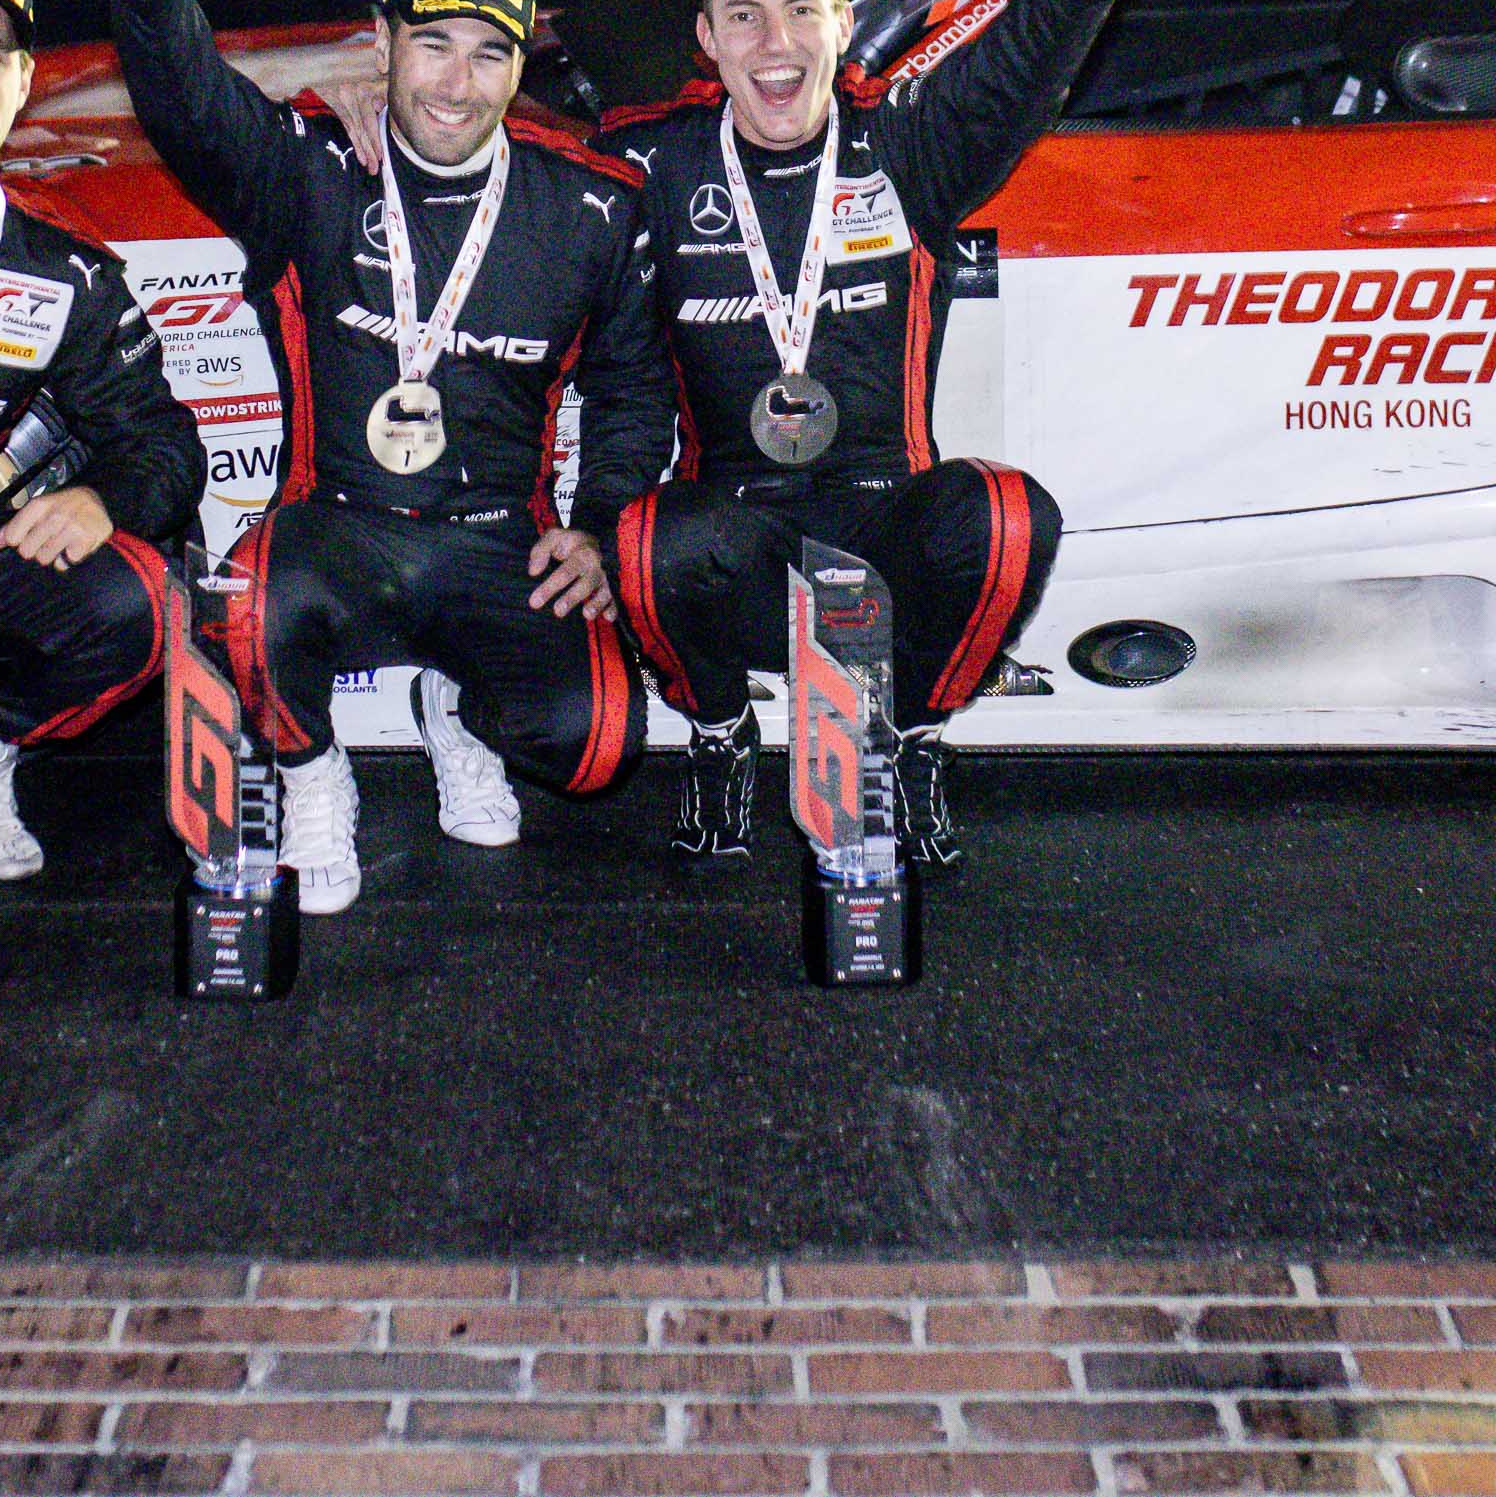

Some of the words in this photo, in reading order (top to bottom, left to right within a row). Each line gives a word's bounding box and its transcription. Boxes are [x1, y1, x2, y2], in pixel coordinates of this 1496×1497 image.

[845, 208, 893, 225] CHALLENGE
[140, 271, 244, 291] FANAT
[197, 327, 264, 340] CHALLENGE
[162, 344, 195, 353] ERICA
[166, 359, 191, 367] ERED
[196, 356, 242, 374] aws
[194, 401, 282, 418] ROWDSTRIK
[1285, 401, 1373, 430] HONG
[1385, 399, 1471, 428] KONG
[211, 445, 278, 483] aw
[333, 686, 378, 694] OOLANTS
[855, 935, 878, 948] PRO
[215, 948, 239, 961] PRO
